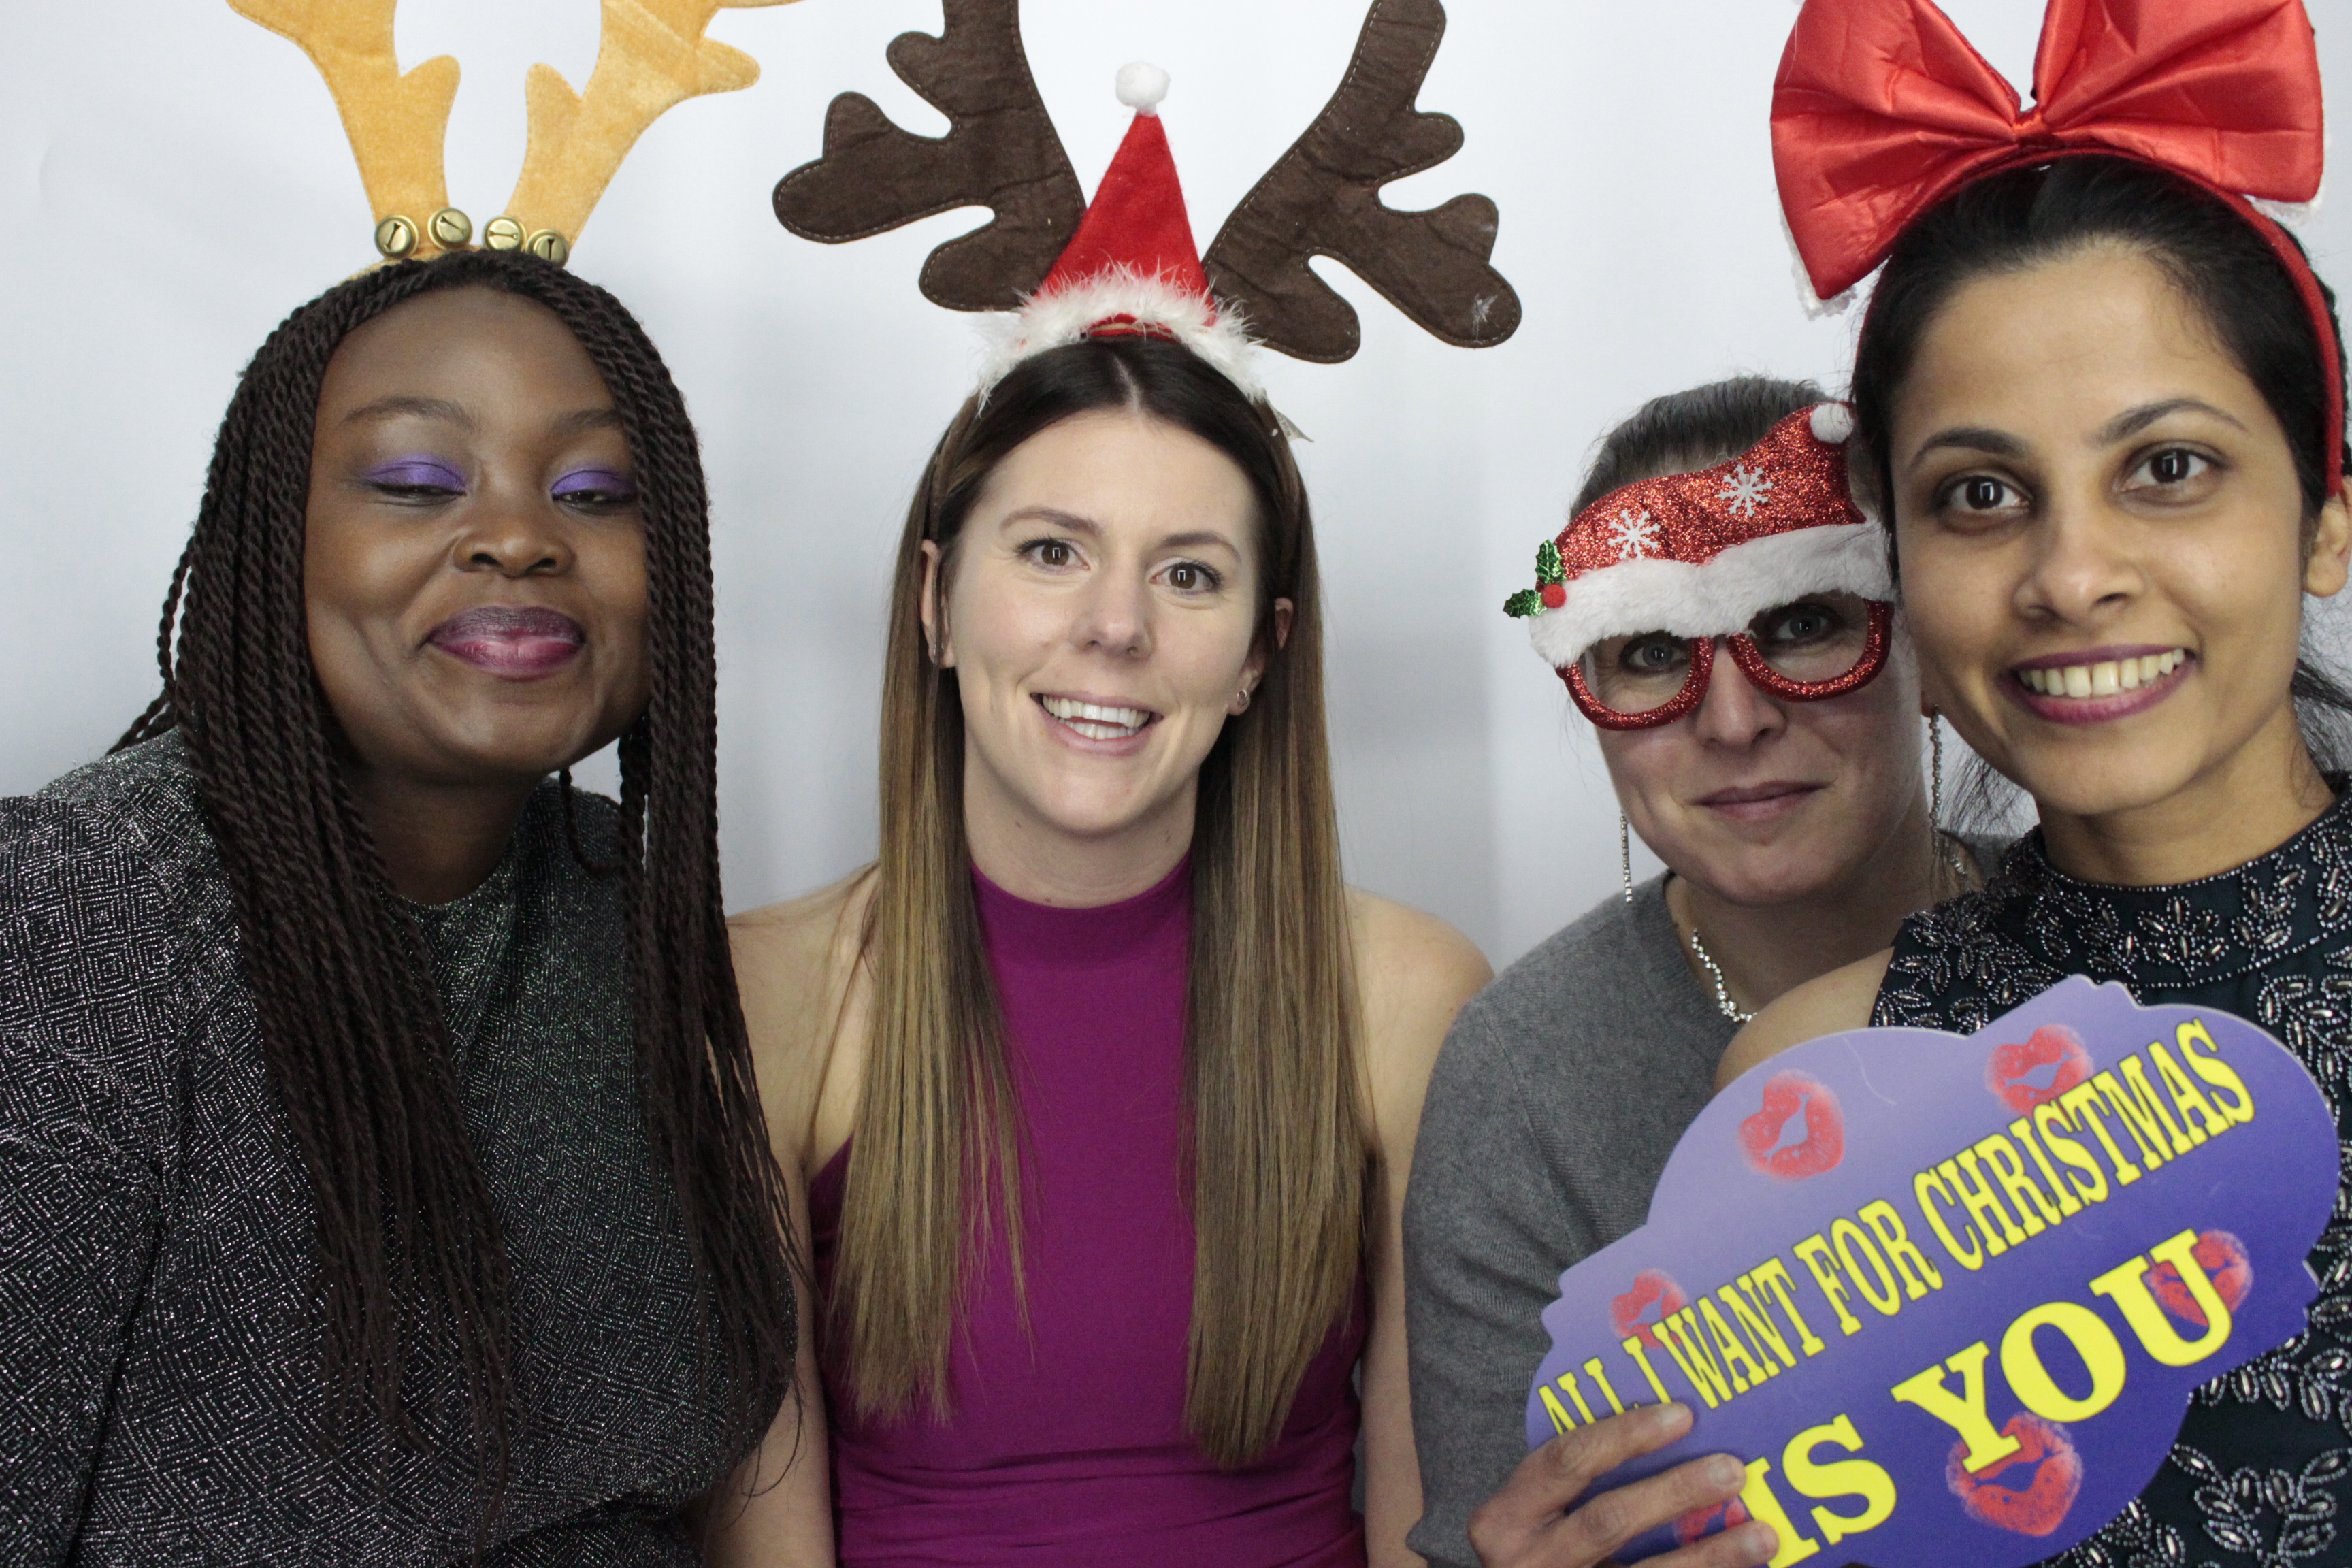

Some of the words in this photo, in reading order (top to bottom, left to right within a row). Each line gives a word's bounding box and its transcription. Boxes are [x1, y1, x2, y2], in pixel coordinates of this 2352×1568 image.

[1621, 1335, 1673, 1405] I
[1650, 1256, 1827, 1410] WANT
[1792, 1198, 1944, 1337] FOR
[1913, 1017, 2256, 1271] CHRISTMAS
[1738, 1412, 1897, 1568] IS
[1890, 1228, 2232, 1474] YOU
